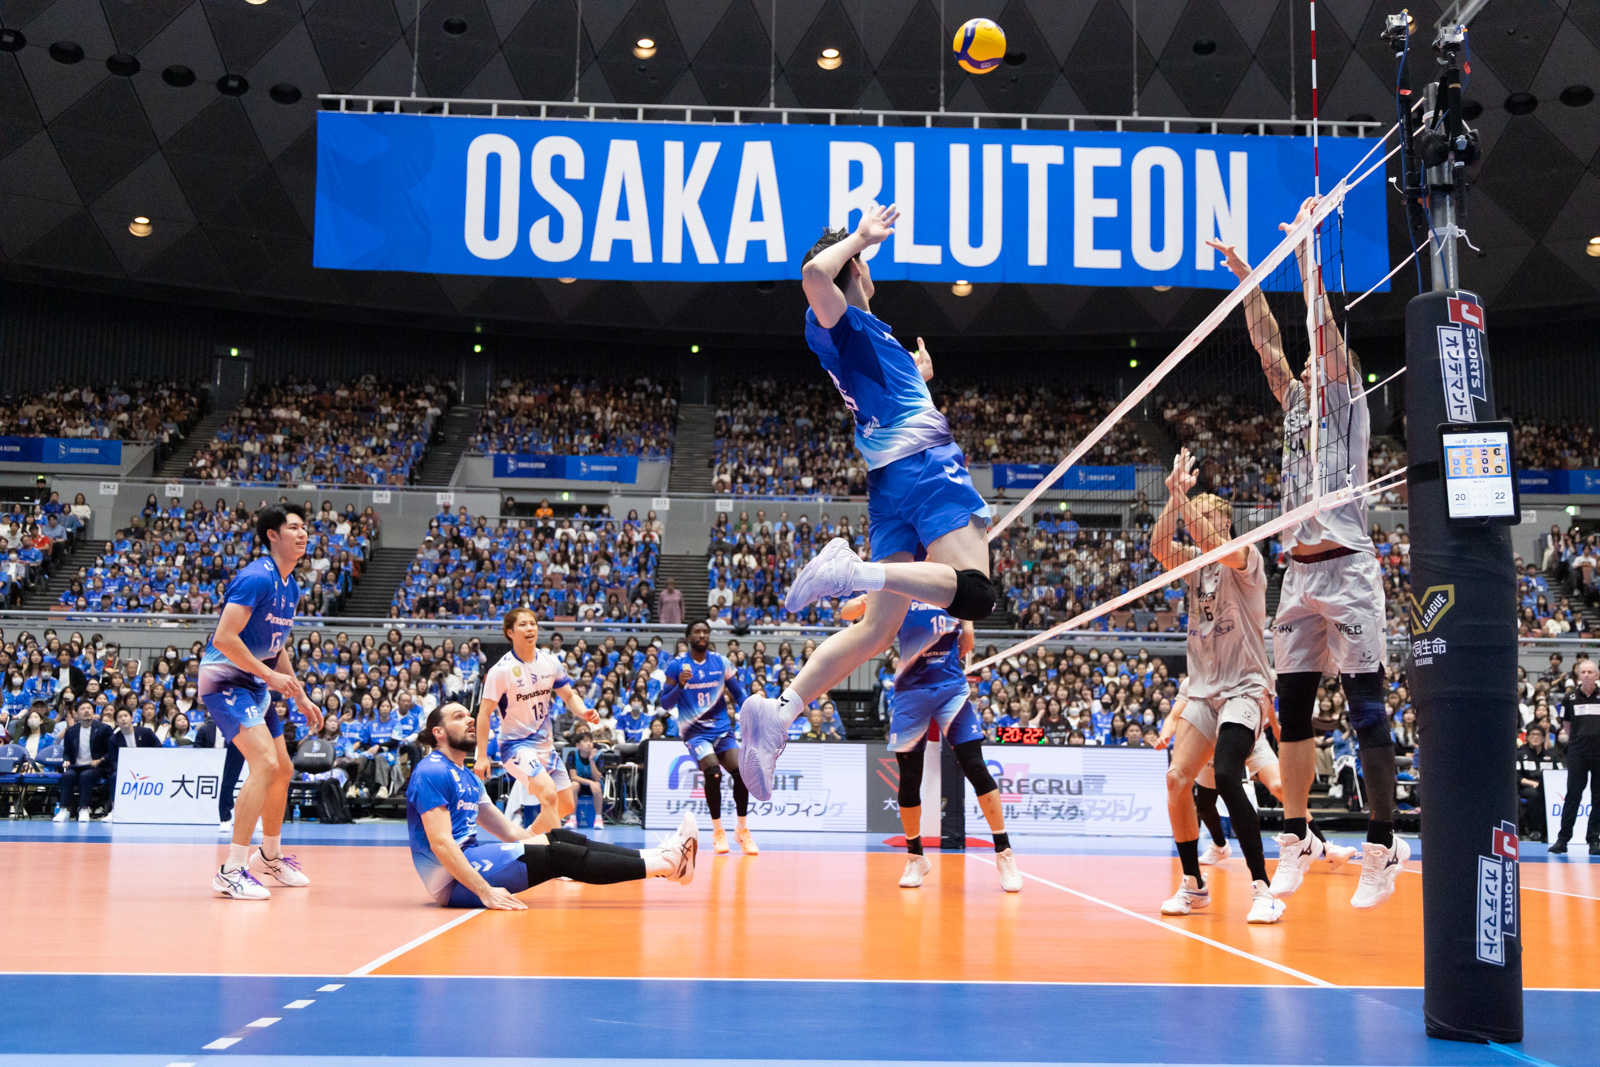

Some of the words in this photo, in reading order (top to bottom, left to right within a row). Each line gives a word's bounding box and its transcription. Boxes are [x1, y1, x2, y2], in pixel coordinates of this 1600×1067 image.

[464, 133, 787, 264] OSAKA
[829, 141, 1248, 271] BLUTEON
[1461, 304, 1479, 324] J
[1466, 328, 1480, 388] SPORTS
[1446, 336, 1468, 415] オンデマンド
[1454, 493, 1466, 501] 20
[1494, 492, 1506, 500] 22
[1204, 606, 1214, 621] 6
[1422, 593, 1447, 627] LEAGUE
[930, 615, 947, 635] 19
[1412, 637, 1447, 657] 同生命
[684, 681, 719, 689] Panasonic
[697, 692, 711, 707] 81
[245, 706, 258, 719] 15
[532, 702, 544, 720] 13
[529, 759, 539, 769] 13
[121, 782, 164, 800] DAIDO
[1503, 836, 1516, 856] J
[1504, 861, 1513, 925] SPORTS
[1484, 869, 1498, 954] オンデマンド
